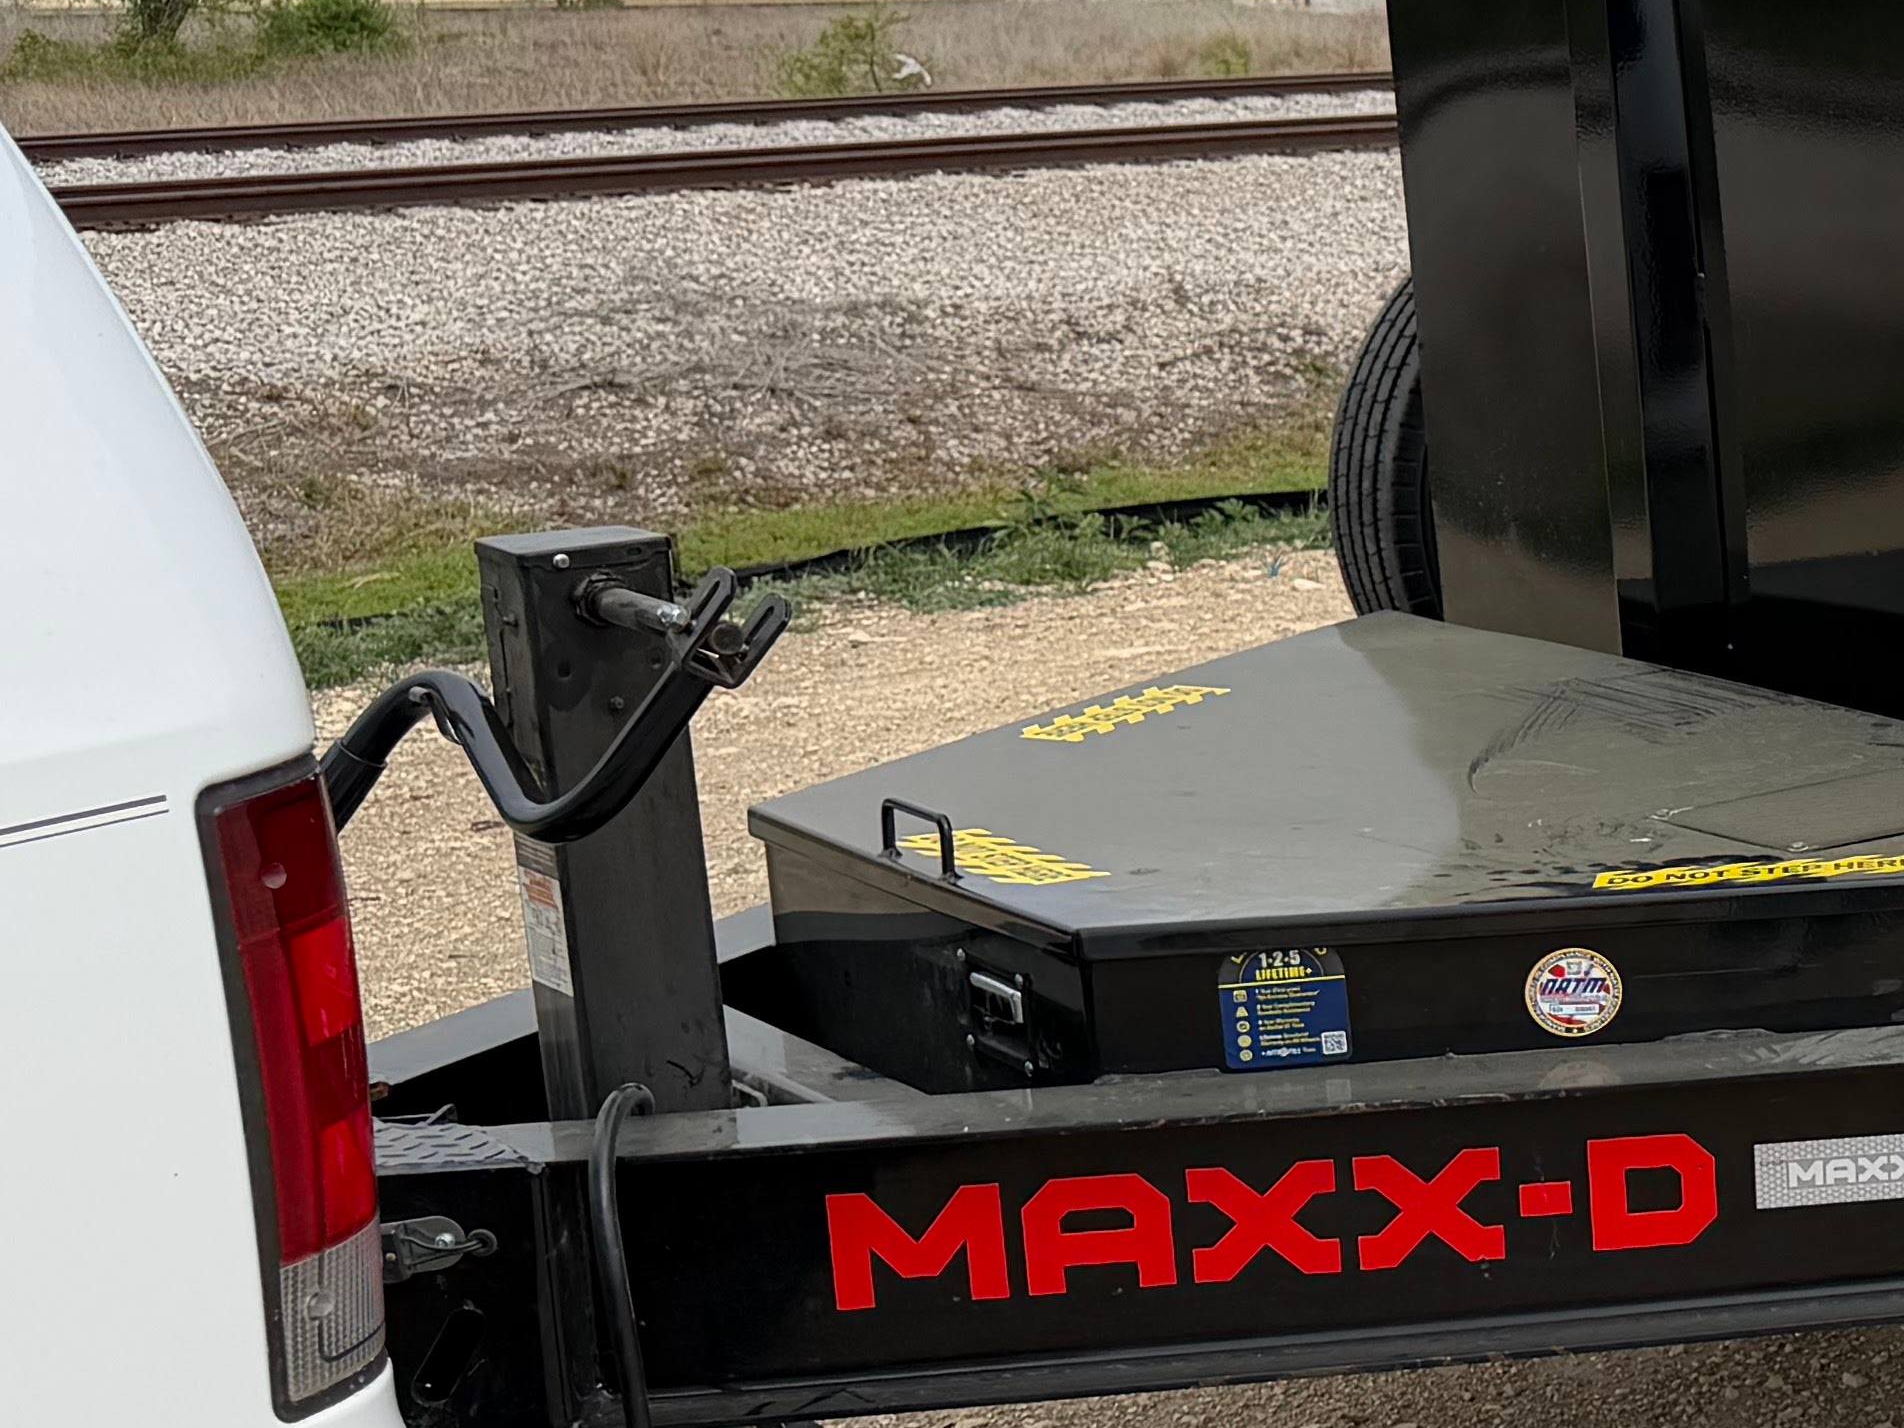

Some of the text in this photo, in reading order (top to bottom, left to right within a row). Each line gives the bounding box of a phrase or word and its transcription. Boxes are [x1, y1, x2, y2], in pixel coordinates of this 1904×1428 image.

[1607, 874, 1653, 886] DO
[1665, 869, 1733, 882] NOT
[1741, 862, 1822, 877] STEP
[826, 1133, 1718, 1311] MAXX-D
